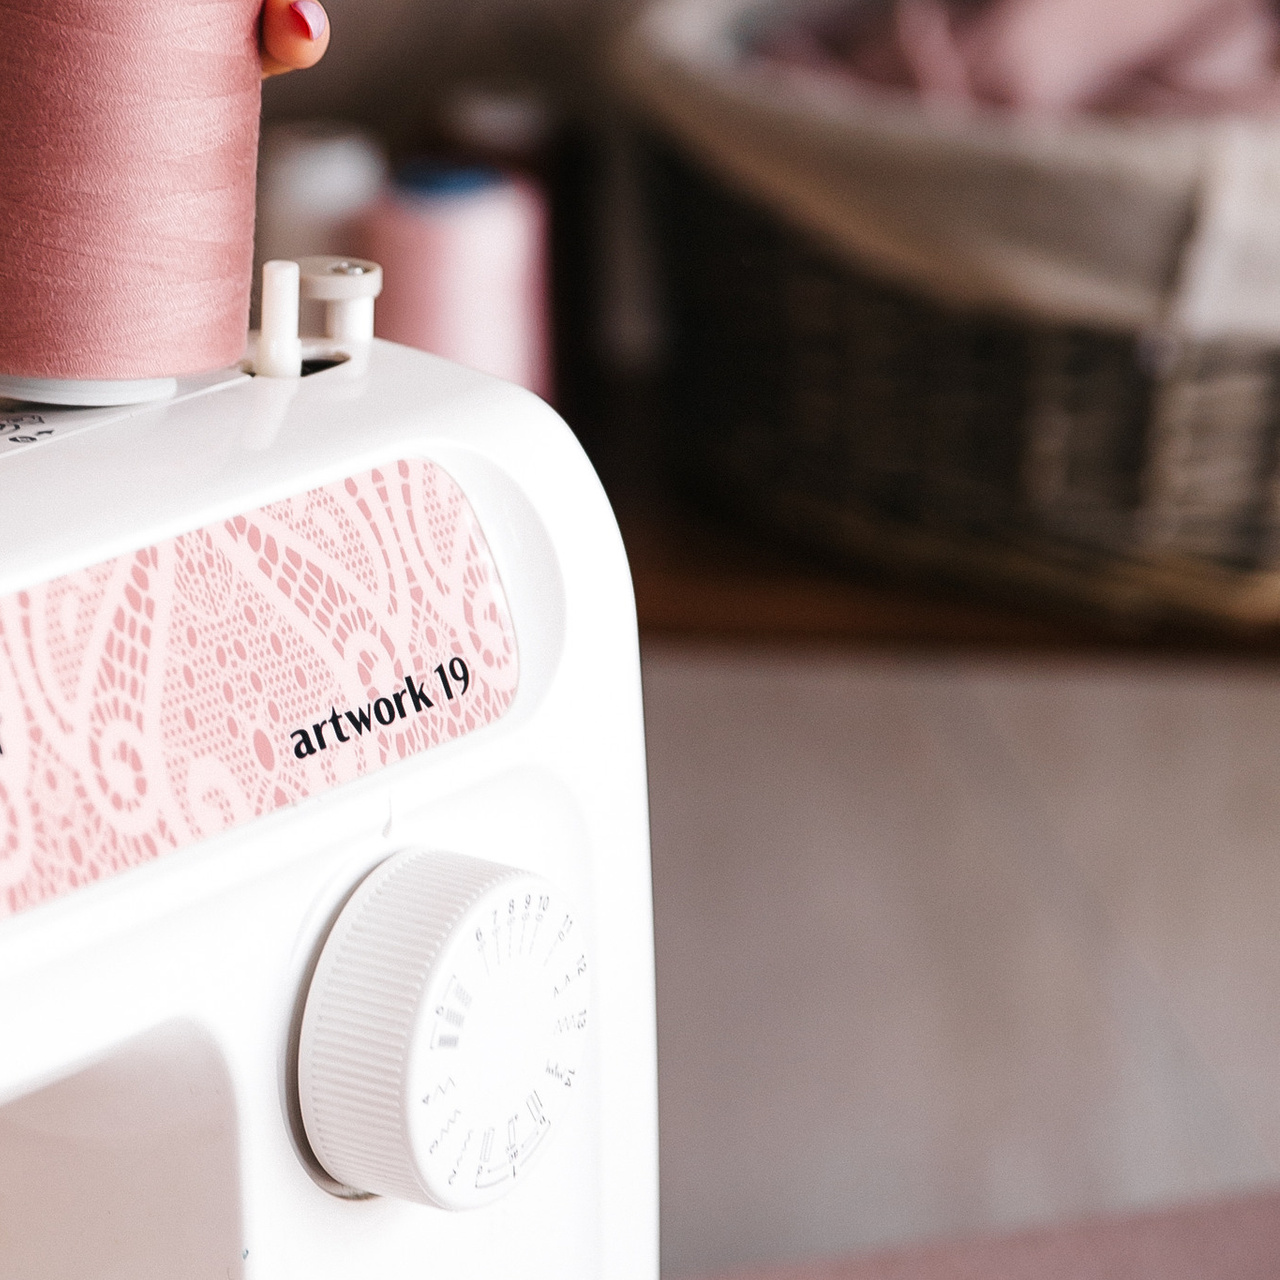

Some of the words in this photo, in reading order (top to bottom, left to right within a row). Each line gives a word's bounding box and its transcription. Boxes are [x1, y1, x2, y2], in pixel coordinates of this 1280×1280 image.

[289, 675, 435, 760] artwork
[433, 656, 470, 701] 19
[507, 898, 515, 915] 8
[537, 895, 551, 912] 10
